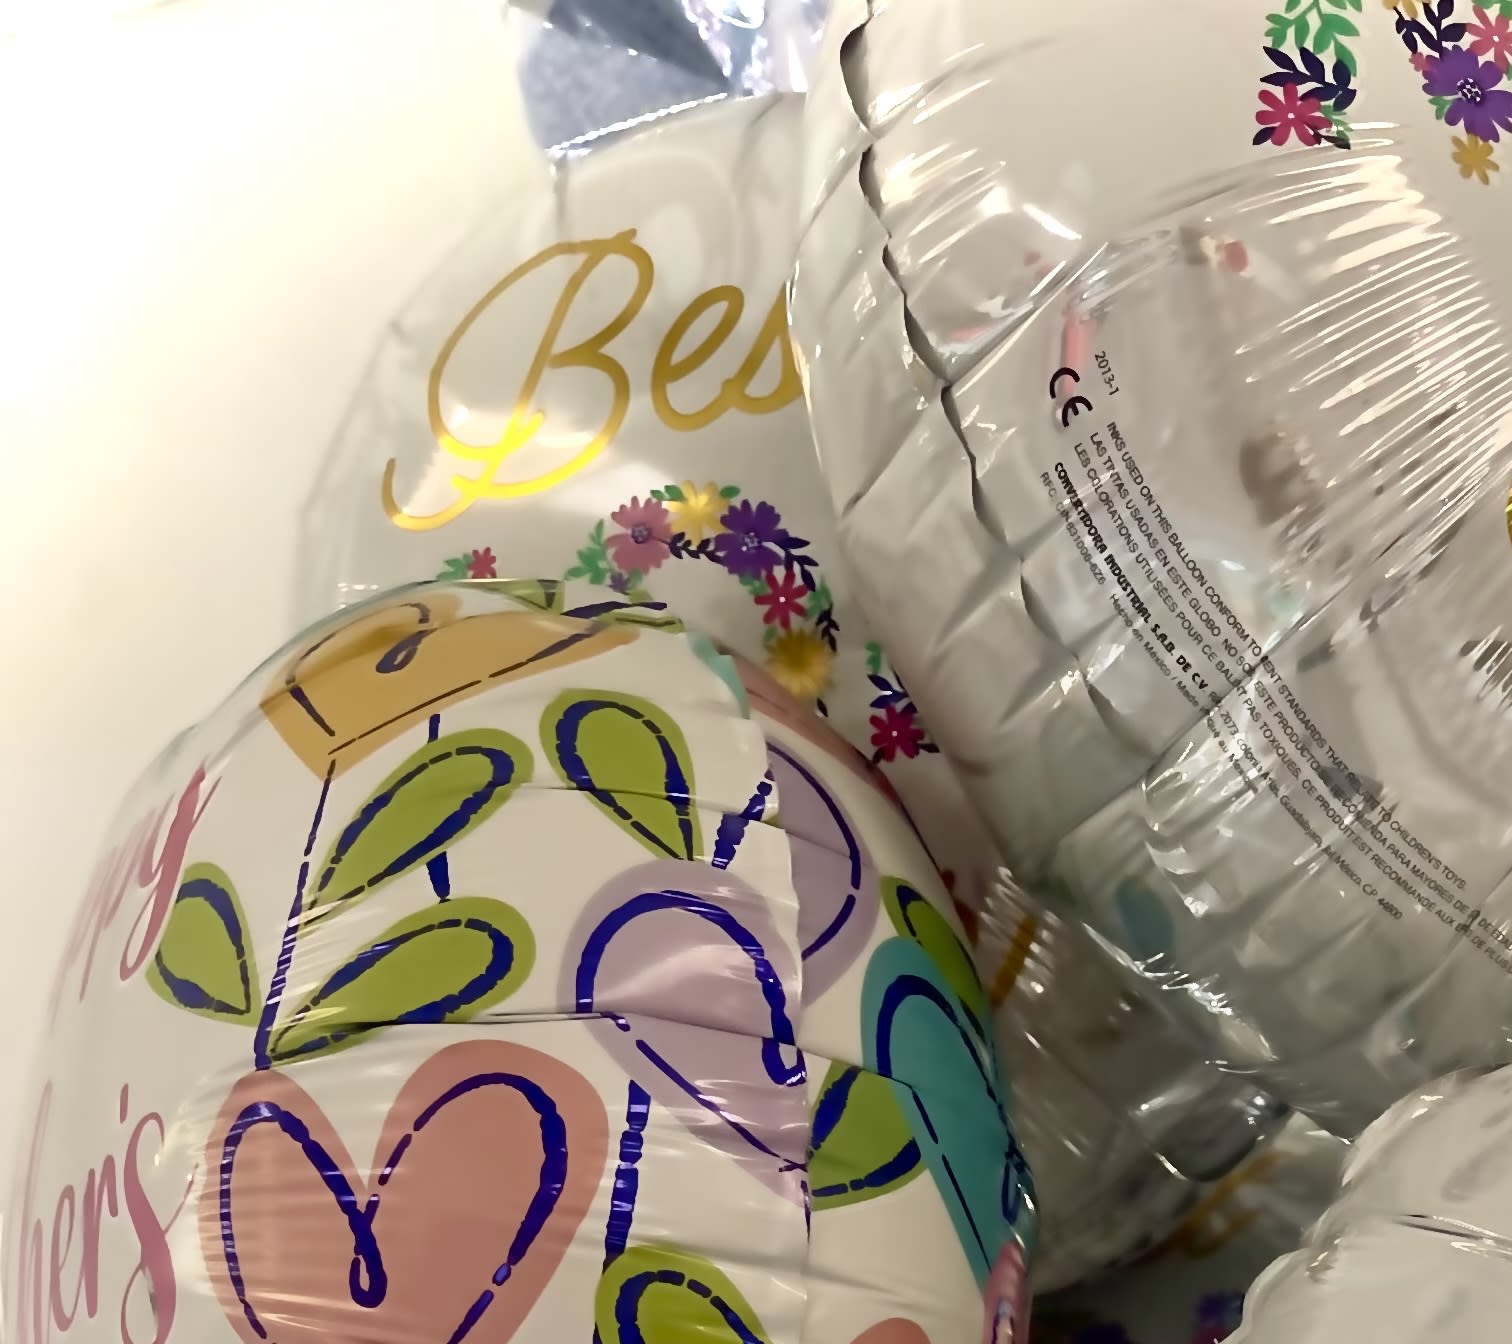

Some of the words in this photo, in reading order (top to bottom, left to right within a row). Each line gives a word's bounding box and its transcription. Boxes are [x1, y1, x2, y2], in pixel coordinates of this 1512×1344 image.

[380, 228, 803, 530] Bes
[1049, 366, 1093, 429] CE
[1091, 350, 1122, 395] 2013-1
[1071, 442, 1092, 469] LES
[1173, 610, 1205, 647] POUR
[1200, 642, 1220, 662] CE
[1241, 696, 1263, 723] PAS
[1299, 776, 1318, 797] CE
[1313, 793, 1357, 839] PRODUIT
[1351, 834, 1373, 857] EST
[1433, 907, 1456, 928] AUX
[1088, 431, 1108, 457] LAS
[1123, 498, 1160, 549] USADAS
[1153, 548, 1171, 568] EN
[1164, 565, 1192, 599] ESTE
[1219, 637, 1239, 658] NO
[1251, 680, 1277, 712] ESTE
[1271, 709, 1321, 771] PRODUCTO
[1385, 842, 1412, 869] PARA
[1408, 863, 1455, 905] MAYORES
[1451, 898, 1470, 916] DE
[1476, 916, 1494, 934] DE
[1102, 553, 1154, 624] INDUSTRIAL
[1174, 653, 1192, 673] DE
[1104, 421, 1127, 452] INKS
[1119, 451, 1145, 486] USED
[1137, 483, 1157, 506] ON
[1149, 504, 1173, 534] THIS
[1166, 531, 1208, 588] BALLOON
[1202, 585, 1251, 642] CONFORM
[1244, 638, 1264, 658] TO
[1275, 683, 1329, 749] STANDARDS
[1322, 745, 1349, 774] THAT
[1387, 818, 1444, 870] CHILDREN'S
